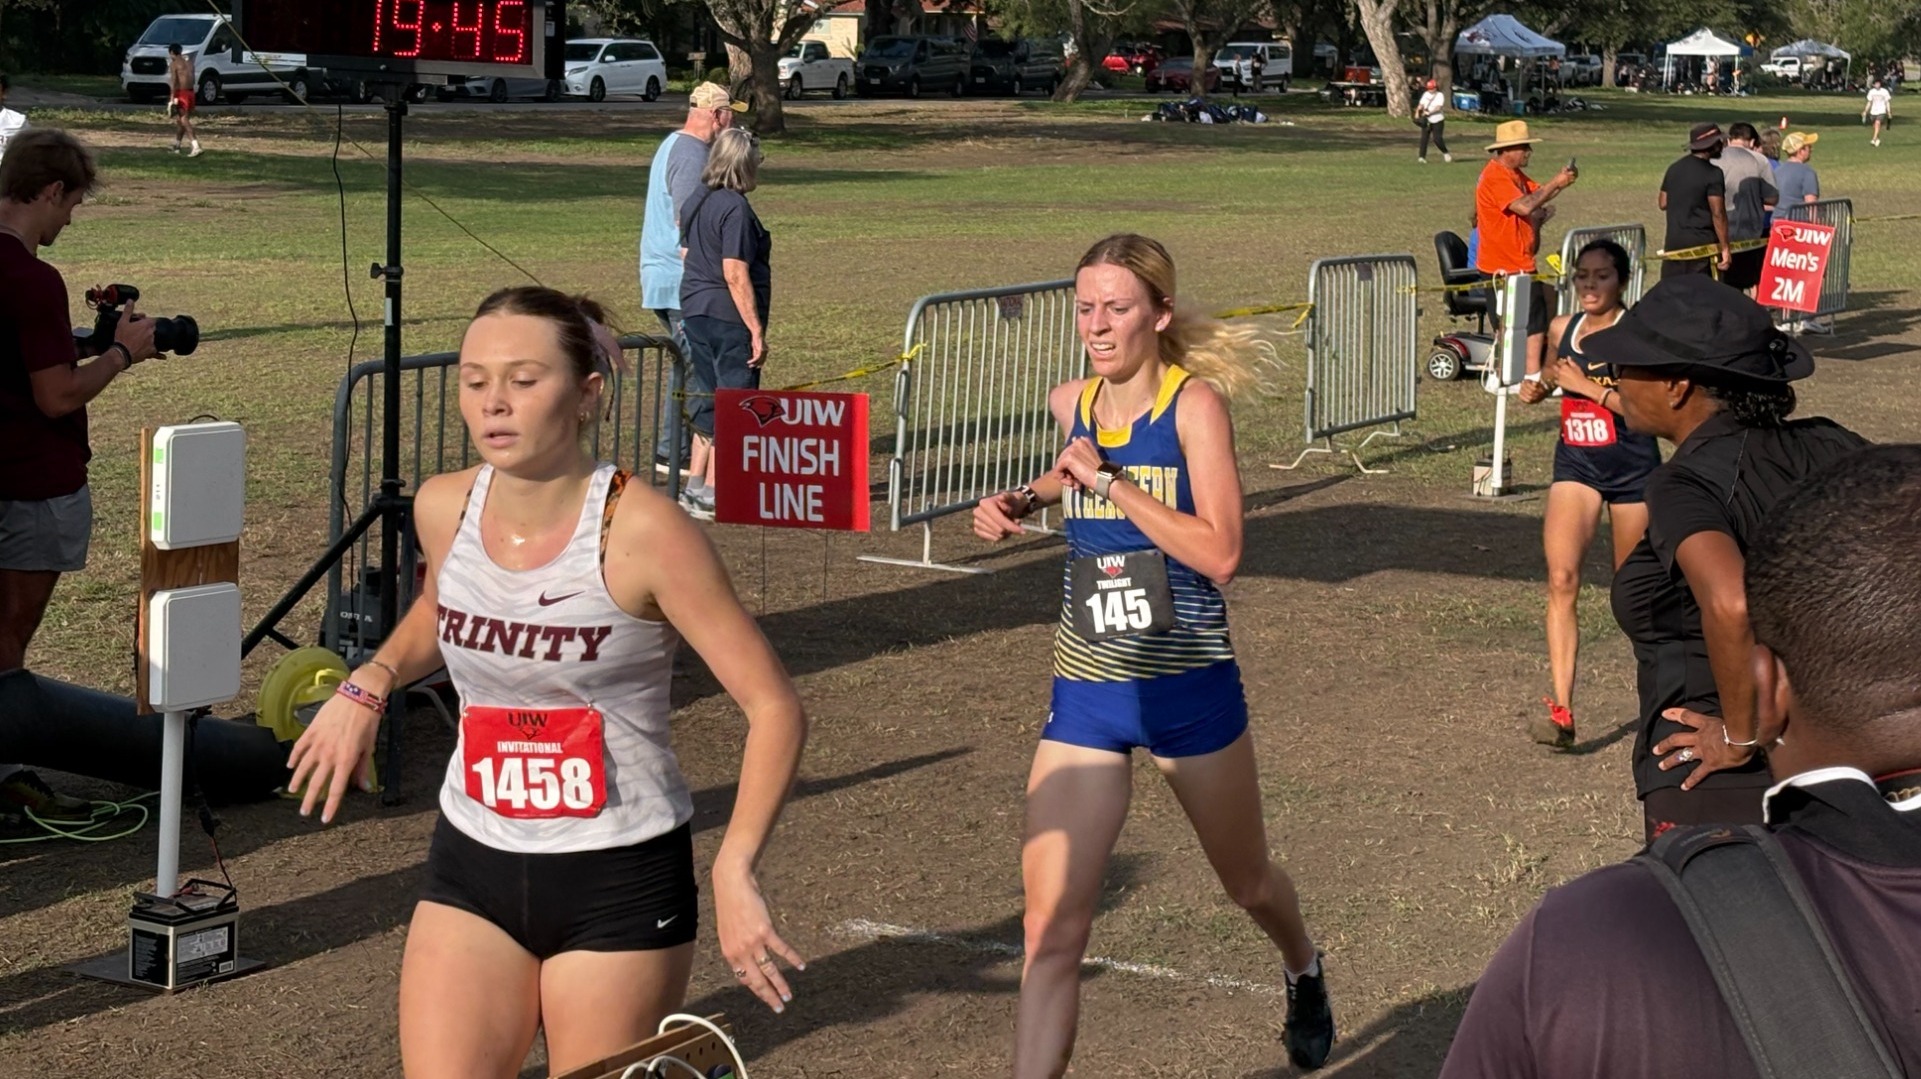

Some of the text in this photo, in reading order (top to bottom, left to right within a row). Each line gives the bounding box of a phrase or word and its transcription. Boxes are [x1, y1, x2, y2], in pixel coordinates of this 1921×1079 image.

[1794, 227, 1832, 246] UIW
[1770, 246, 1820, 272] Men's
[1770, 276, 1805, 304] 2M
[778, 397, 846, 427] UIW
[1564, 418, 1609, 442] 1318
[742, 435, 840, 477] FINISH
[759, 482, 825, 522] LINE
[1096, 555, 1126, 569] UIW
[1096, 577, 1132, 590] TWILIGHT
[1085, 588, 1153, 633] 145
[507, 712, 549, 728] UIW
[497, 741, 564, 754] INVITATIONAL
[471, 757, 594, 810] 1458
